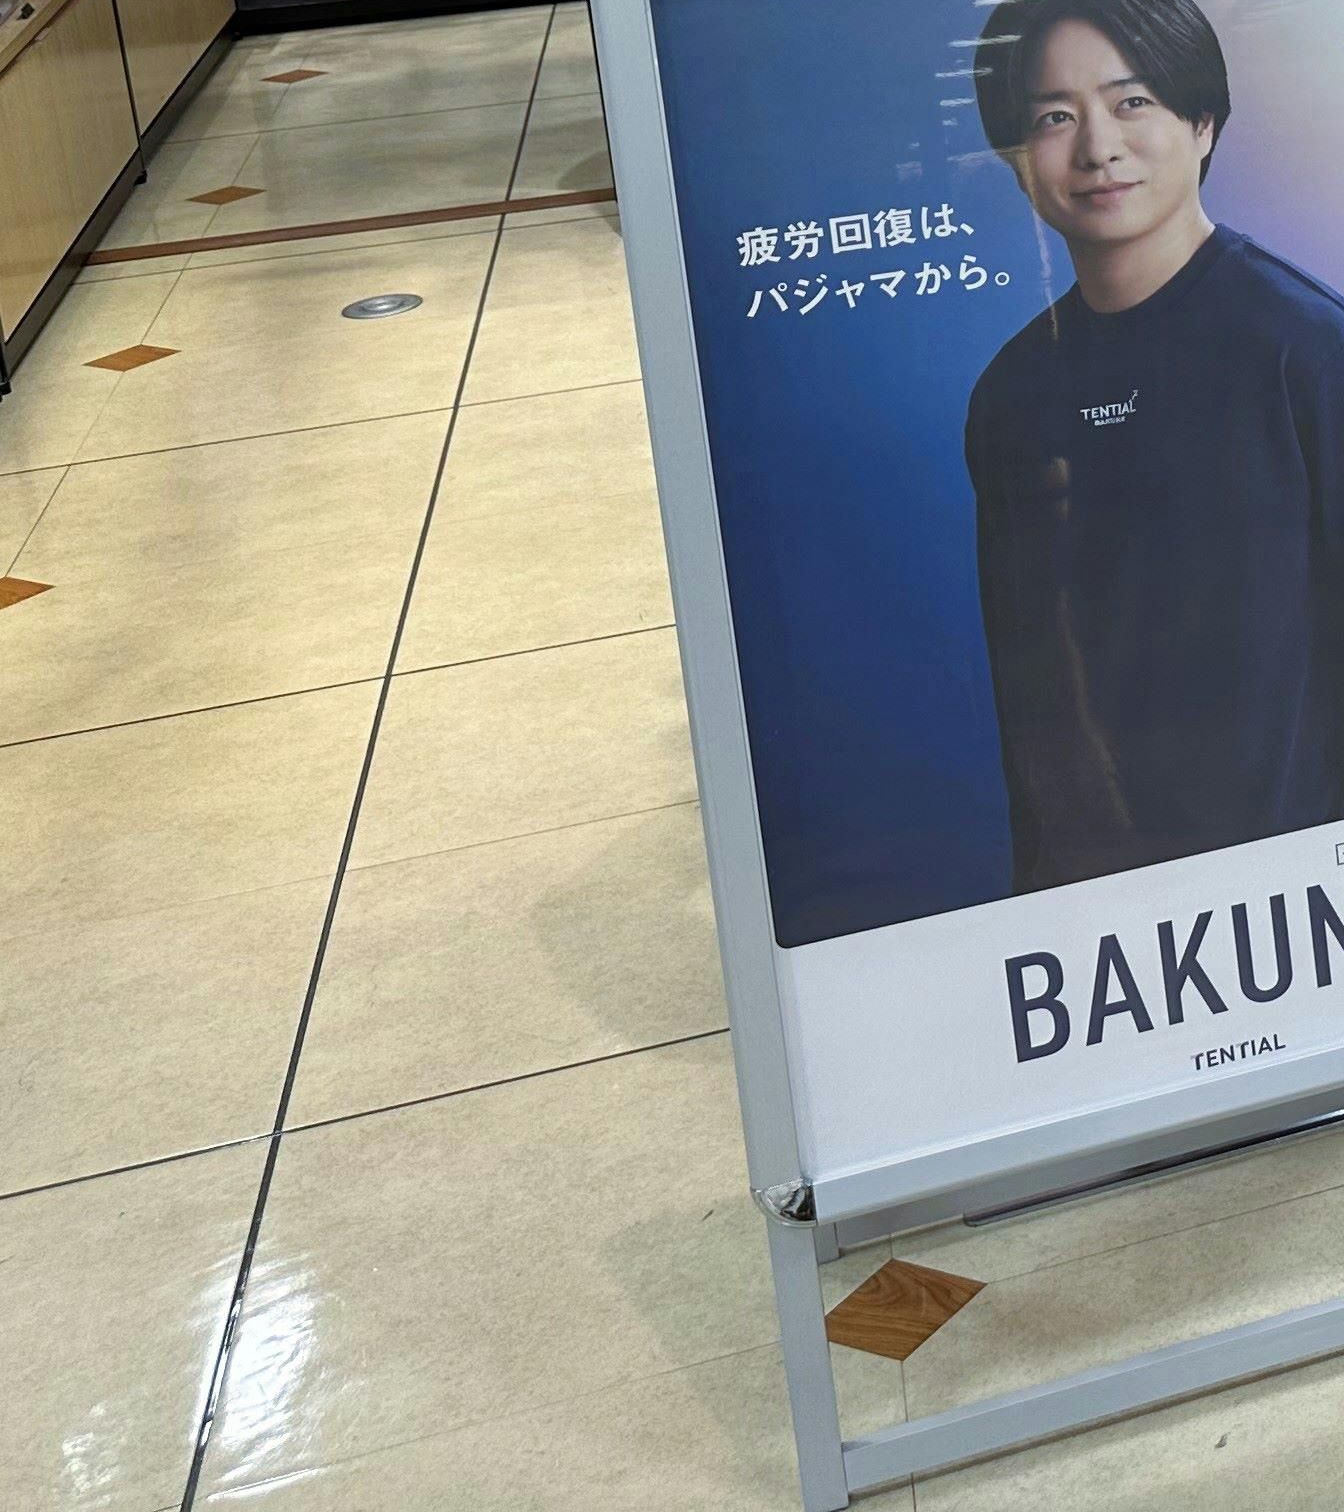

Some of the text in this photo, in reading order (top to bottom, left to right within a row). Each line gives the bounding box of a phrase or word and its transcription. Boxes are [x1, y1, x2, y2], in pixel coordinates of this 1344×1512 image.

[736, 203, 975, 267] 疲労回復は、
[746, 254, 1010, 318] パジャマから。
[1080, 399, 1137, 420] TENTIAL
[1191, 1033, 1287, 1071] TENTIAL
